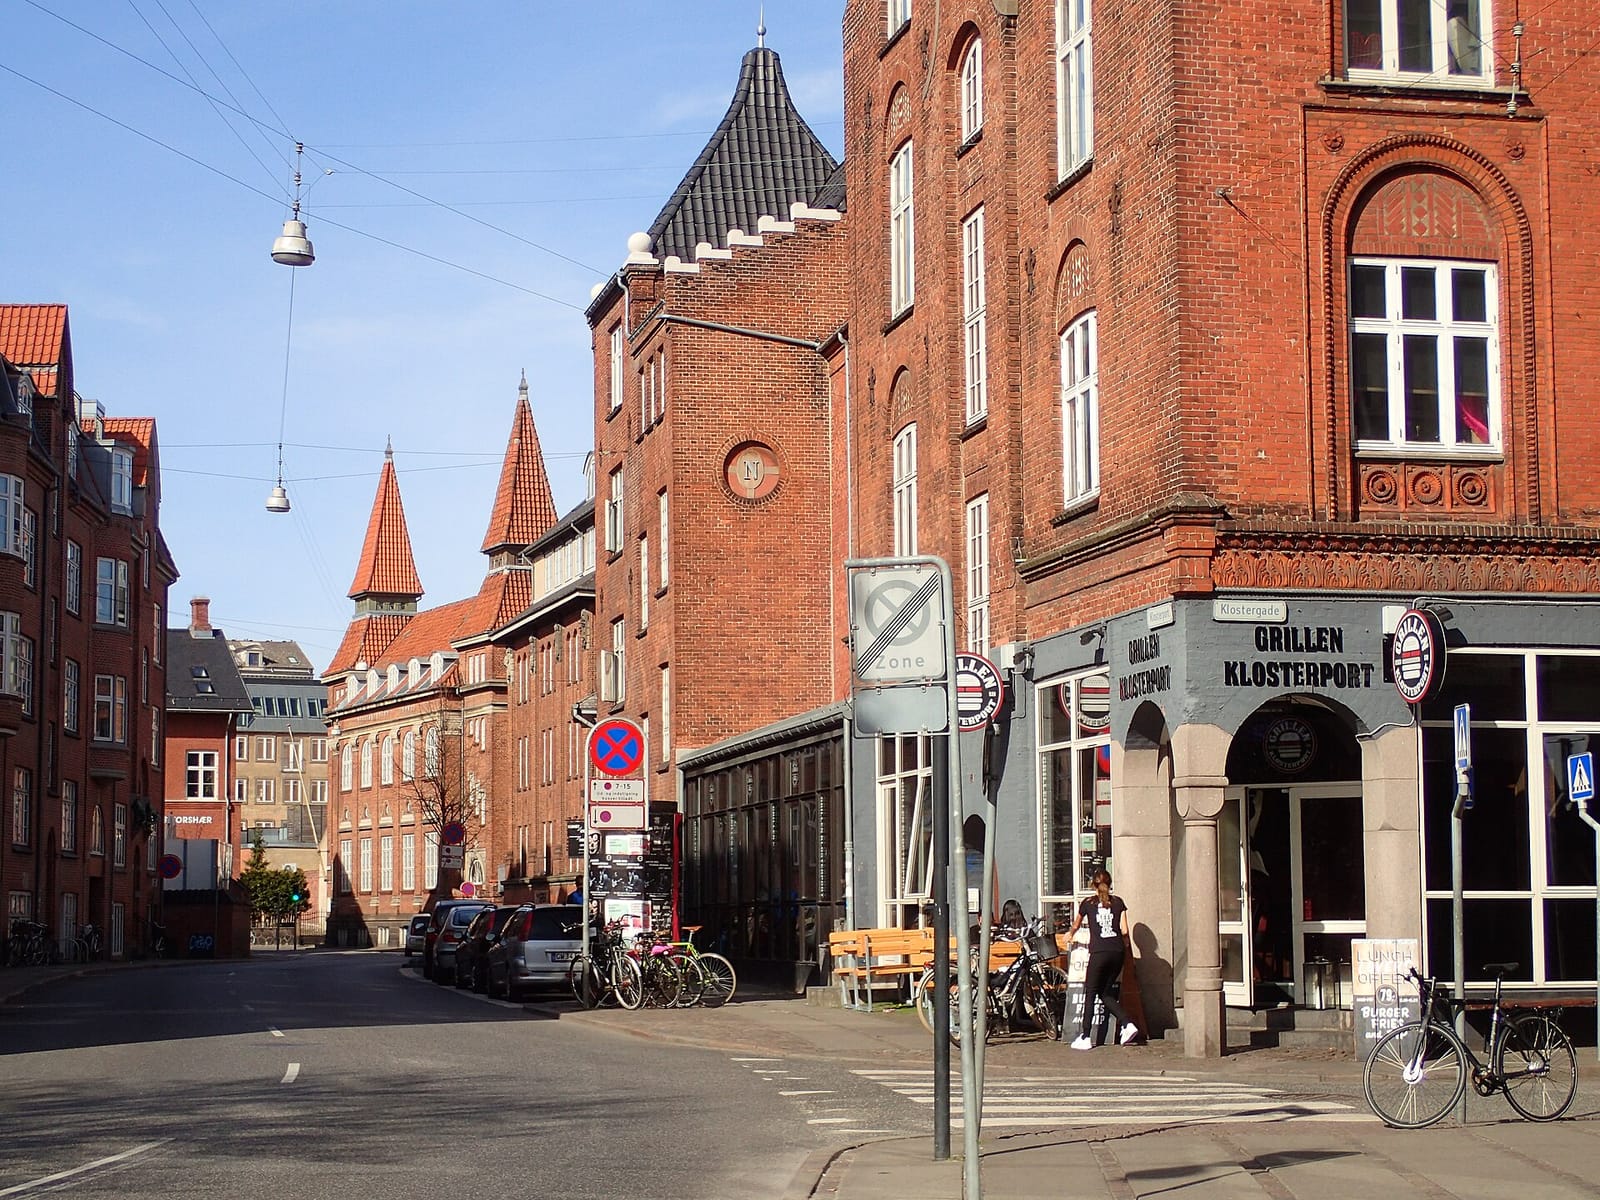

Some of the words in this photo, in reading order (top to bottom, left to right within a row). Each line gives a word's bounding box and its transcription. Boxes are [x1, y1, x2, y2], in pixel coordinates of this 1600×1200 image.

[1220, 603, 1280, 617] Klostergade
[1128, 632, 1160, 665] GRILLEN
[1254, 626, 1344, 653] GRILLEN
[1395, 617, 1429, 655] GRILLEN
[875, 655, 925, 669] Zone
[1224, 661, 1375, 688] KLOSTERPORT
[1119, 664, 1172, 701] KLOSTERPORT
[1357, 951, 1412, 963] LUNCH
[1361, 1006, 1410, 1018] BURGER
